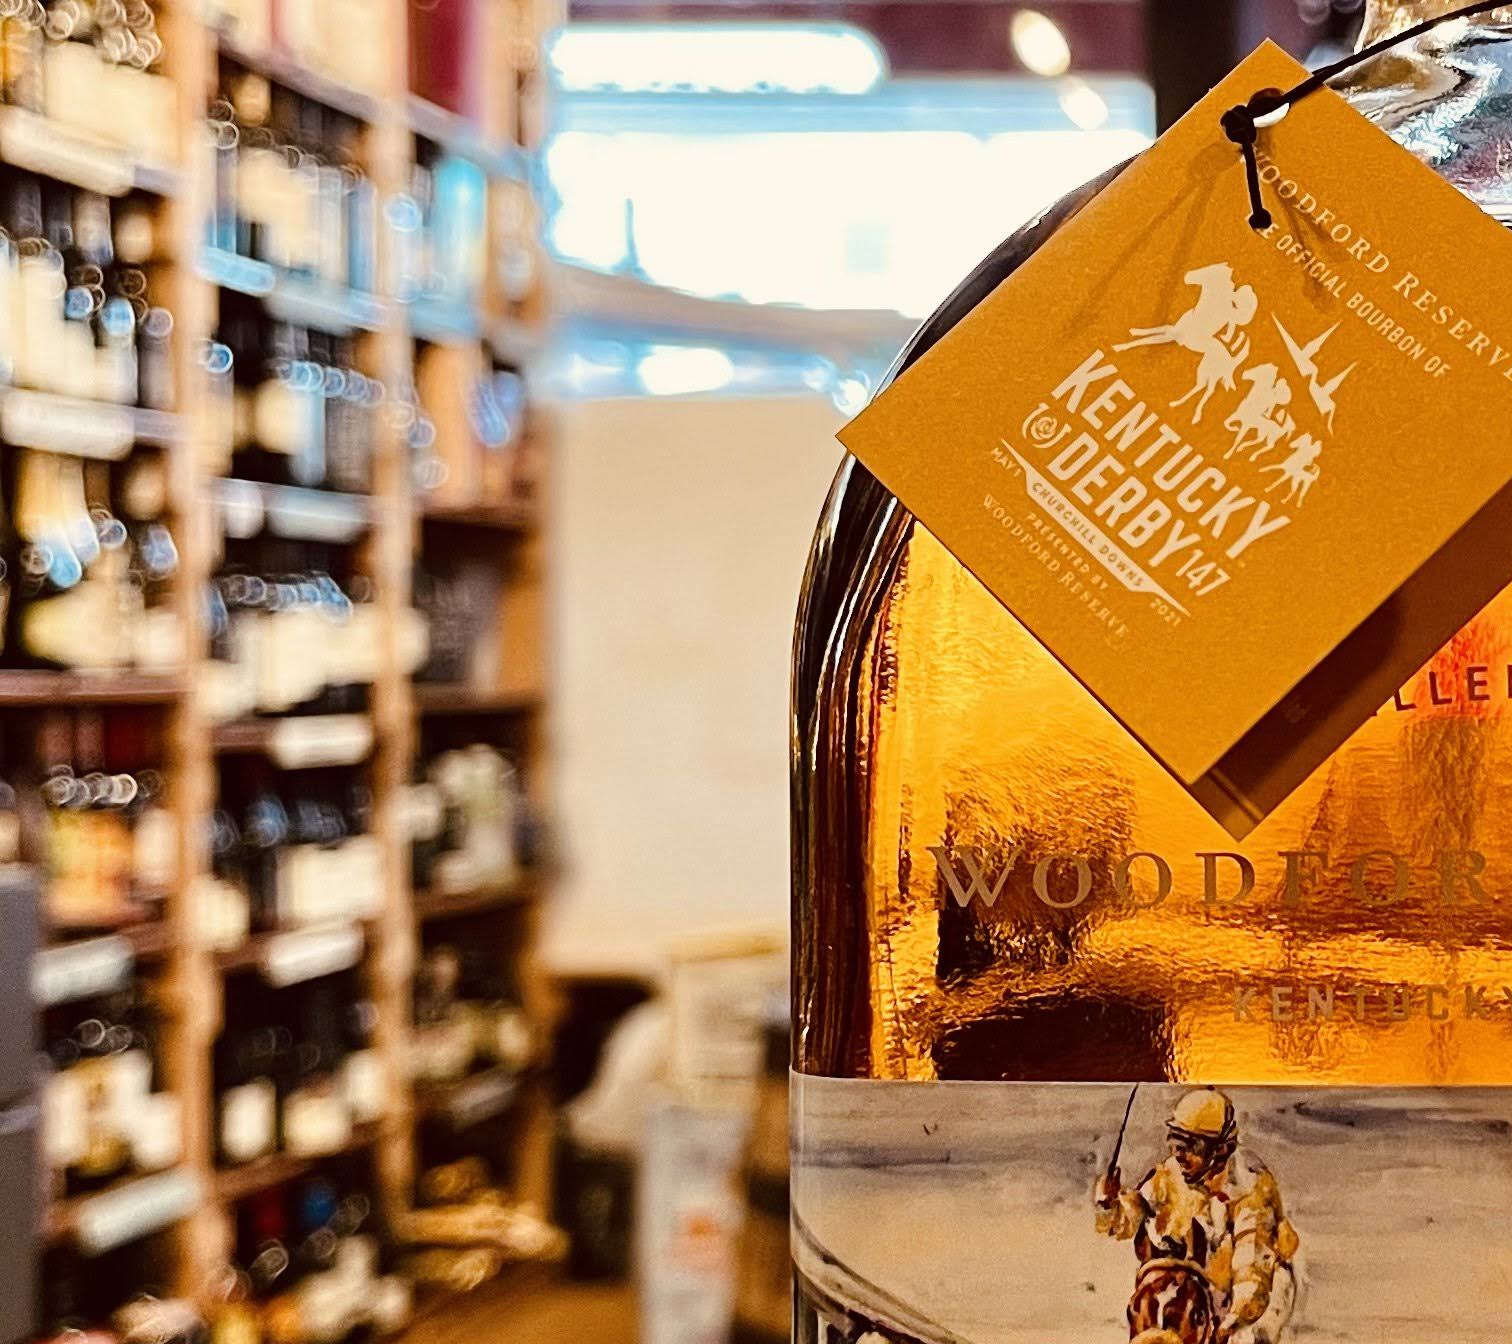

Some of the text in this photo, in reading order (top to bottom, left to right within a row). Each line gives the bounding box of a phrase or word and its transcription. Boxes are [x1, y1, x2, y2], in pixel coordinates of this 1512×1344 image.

[1275, 232, 1452, 378] OFFICIAL BOURBON OF
[988, 446, 1018, 472] MAY
[1046, 430, 1232, 597] DERBY 147
[1050, 348, 1292, 560] KENTUCKY
[982, 492, 1131, 639] WOODFORD RESERVE
[1025, 510, 1109, 594] PRESENTED BY
[1031, 481, 1146, 588] CHURCHILL DOWNS
[1150, 597, 1183, 627] 2021
